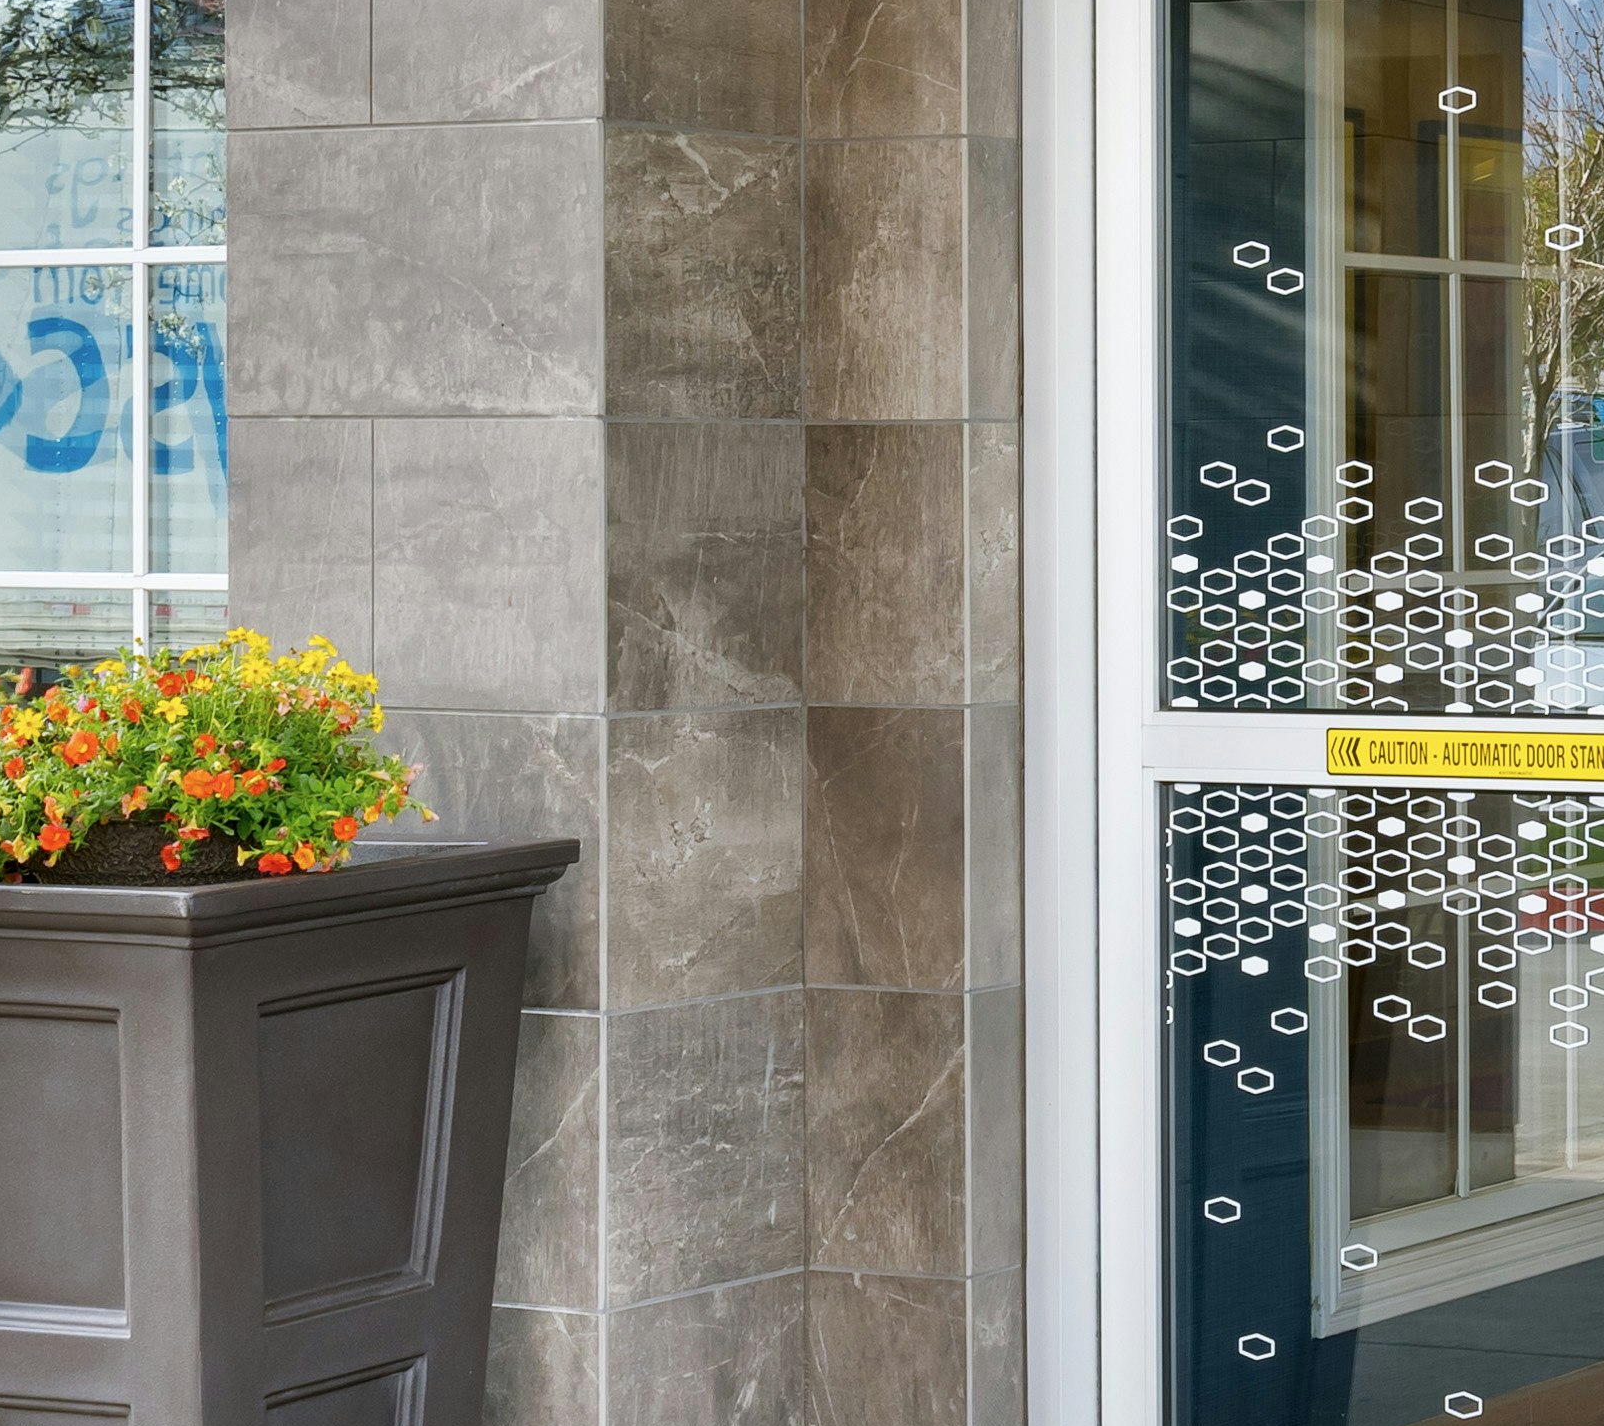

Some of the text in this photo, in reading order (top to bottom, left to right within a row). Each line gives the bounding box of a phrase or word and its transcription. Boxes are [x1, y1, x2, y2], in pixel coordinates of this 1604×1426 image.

[1369, 740, 1428, 765] CAUTION
[1442, 742, 1521, 767] AUTOMATIC
[1526, 744, 1565, 768] DOOR
